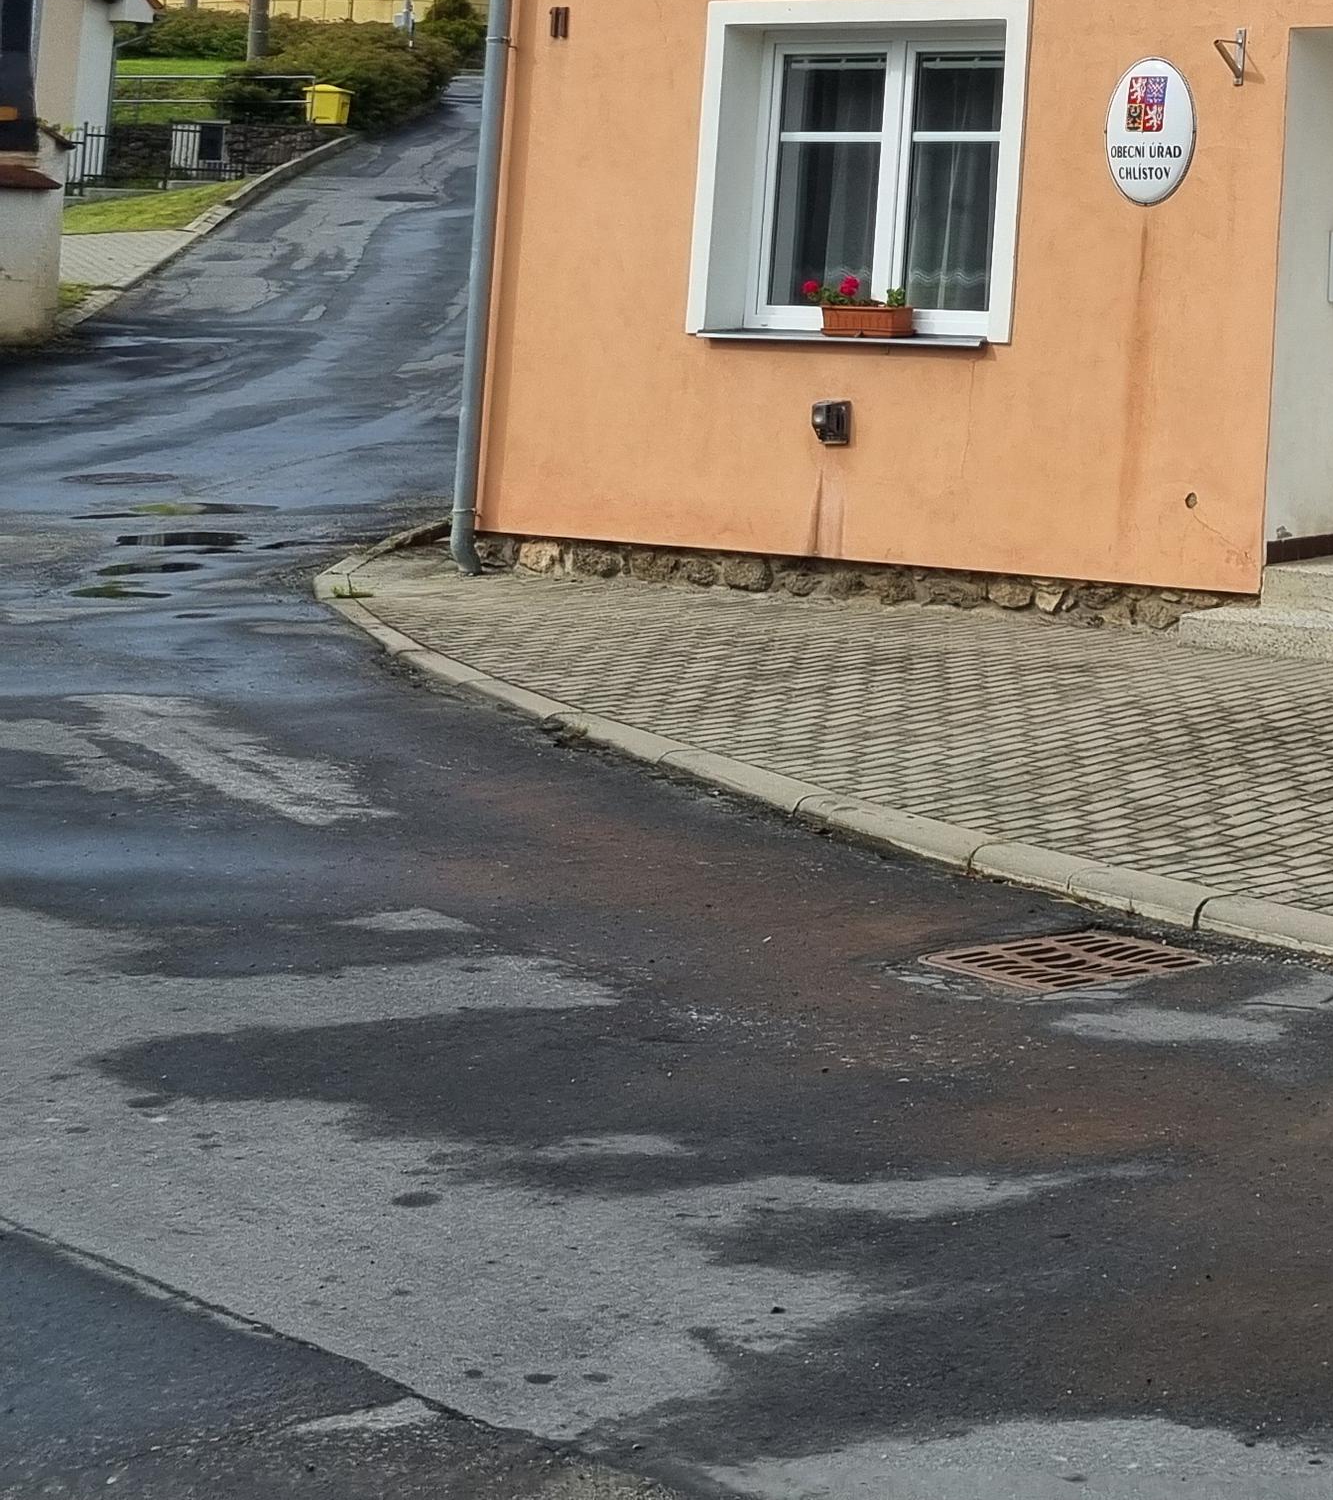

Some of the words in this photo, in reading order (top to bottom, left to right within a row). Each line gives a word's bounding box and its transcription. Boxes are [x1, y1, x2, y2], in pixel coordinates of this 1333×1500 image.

[1110, 142, 1145, 158] OBECNÍ
[1149, 141, 1183, 159] ÚŘAD
[1118, 163, 1172, 180] CHLÍSTOV
